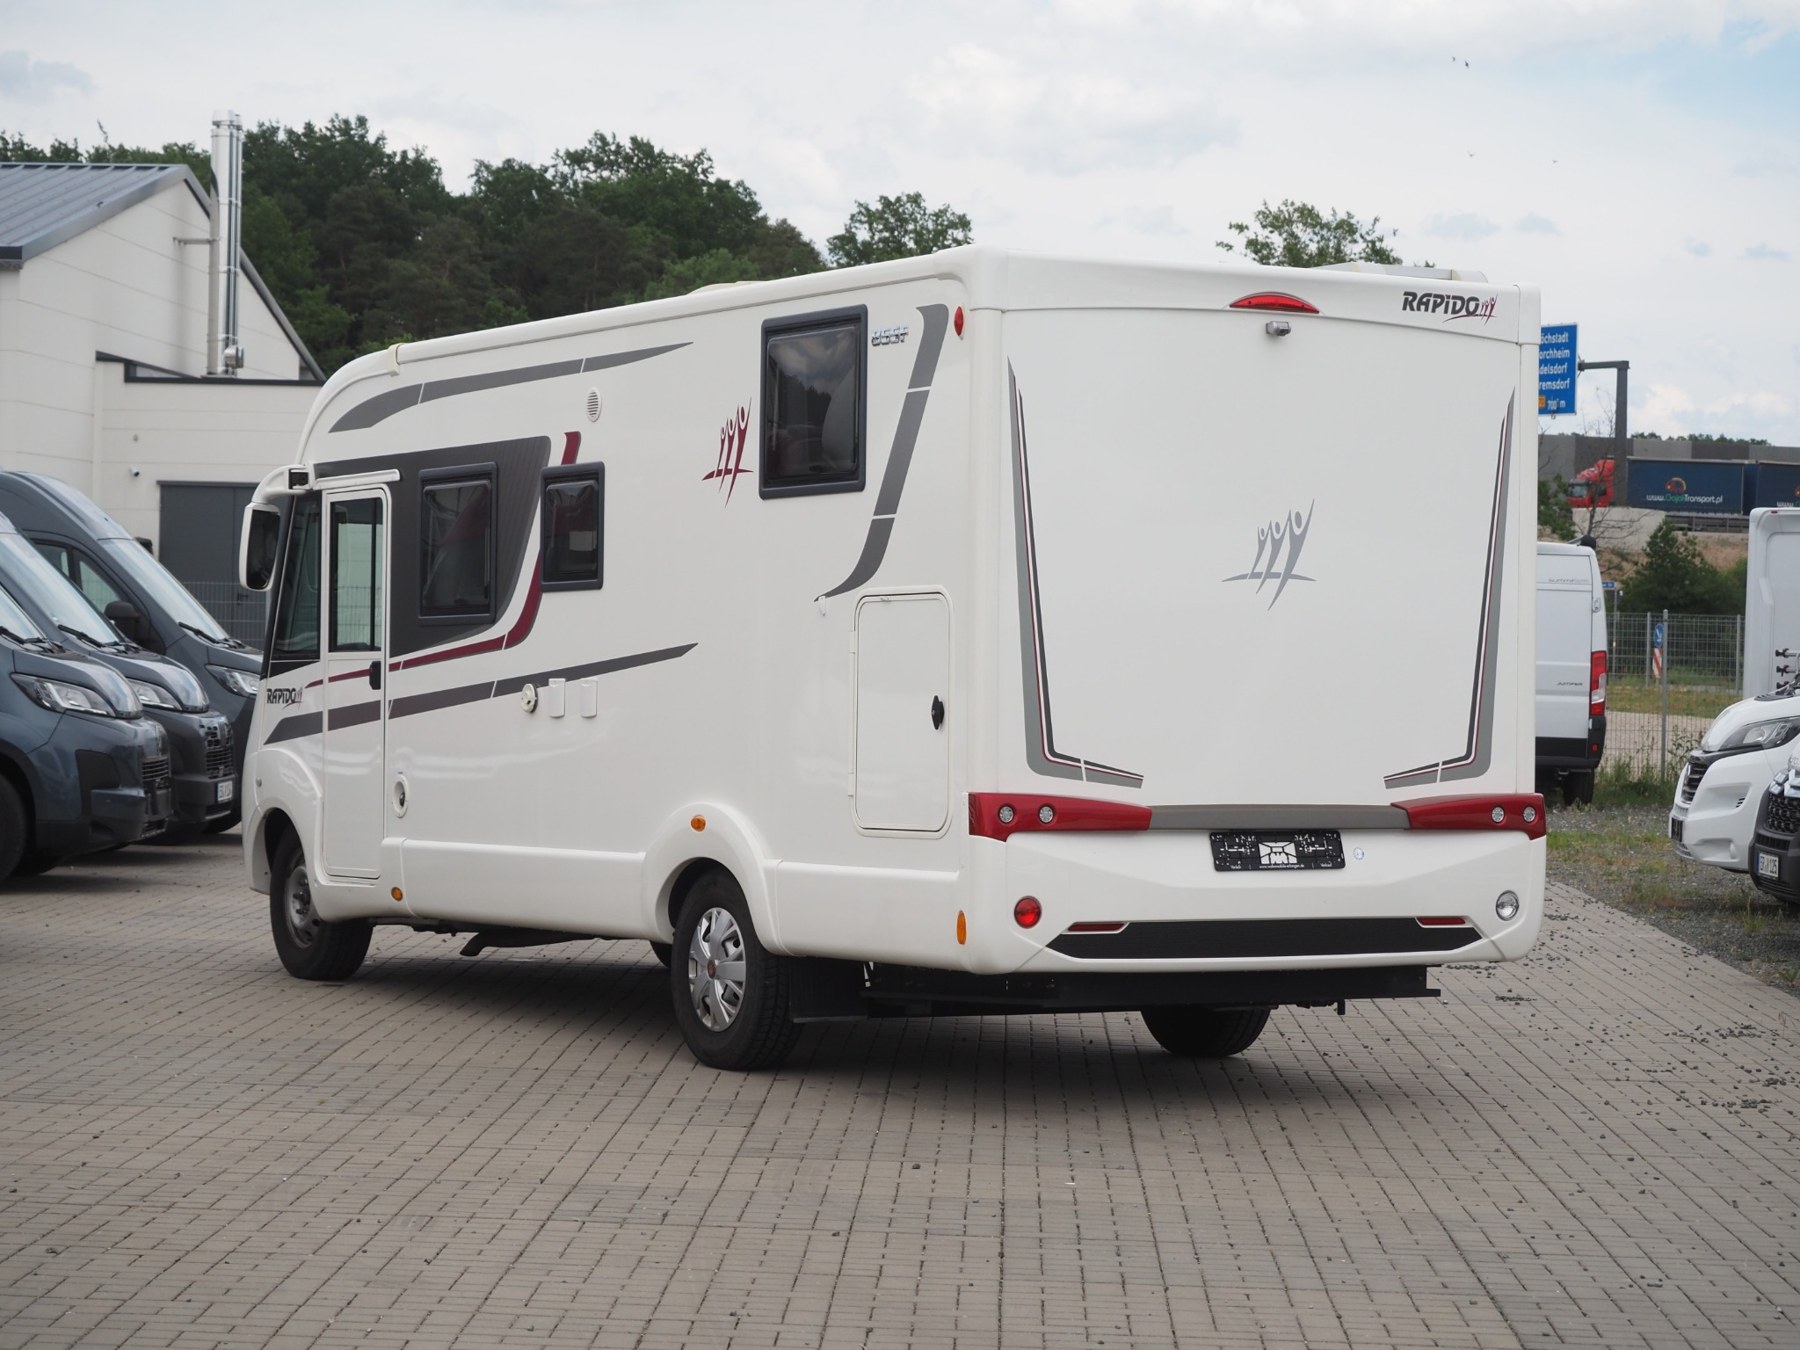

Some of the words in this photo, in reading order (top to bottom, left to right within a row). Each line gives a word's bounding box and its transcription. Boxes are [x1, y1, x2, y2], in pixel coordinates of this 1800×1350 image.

[1402, 291, 1480, 315] RAPIDO
[1540, 332, 1569, 344] öchstadt
[1539, 347, 1570, 360] orchheim
[1539, 362, 1568, 375] delsdorf
[1538, 378, 1570, 391] remsdorf
[267, 688, 297, 704] RAPIDO
